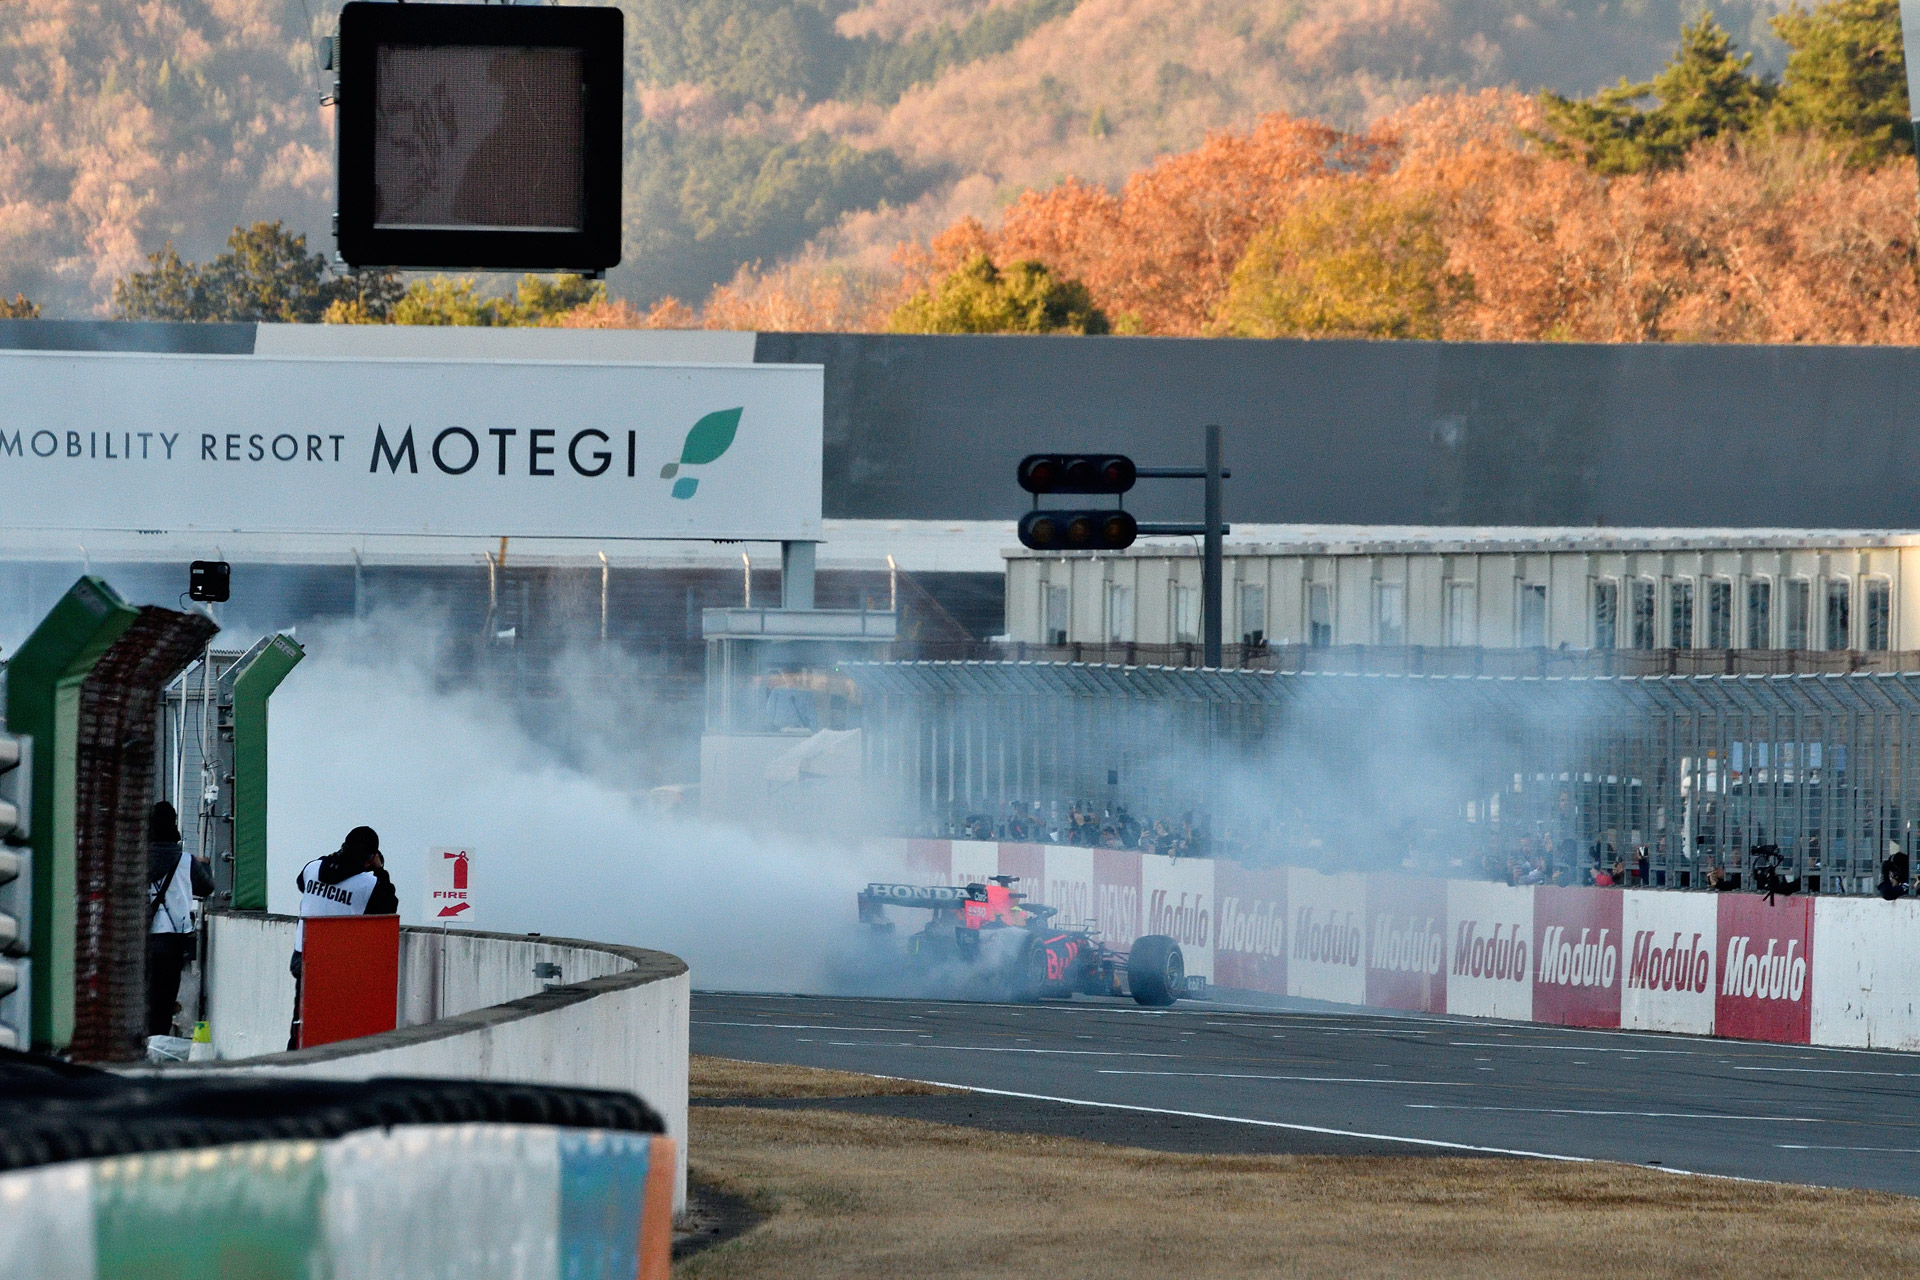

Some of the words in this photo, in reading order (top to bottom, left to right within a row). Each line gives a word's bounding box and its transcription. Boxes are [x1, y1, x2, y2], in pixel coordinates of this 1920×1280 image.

[0, 428, 180, 462] MOBILITY
[200, 433, 346, 463] RESORT
[369, 423, 637, 478] MOTEGI
[305, 879, 353, 906] OFFICIAL
[433, 891, 468, 900] FIRE
[869, 884, 971, 899] HONDA
[1149, 889, 1209, 948] Modulo
[1218, 897, 1284, 957] Modulo
[1293, 906, 1361, 968] Modulo
[1371, 913, 1443, 976] Modulo
[1453, 920, 1528, 983] Modulo
[1537, 926, 1618, 989] Modulo
[1628, 930, 1710, 994] Modulo
[1721, 936, 1807, 1003] Modulo
